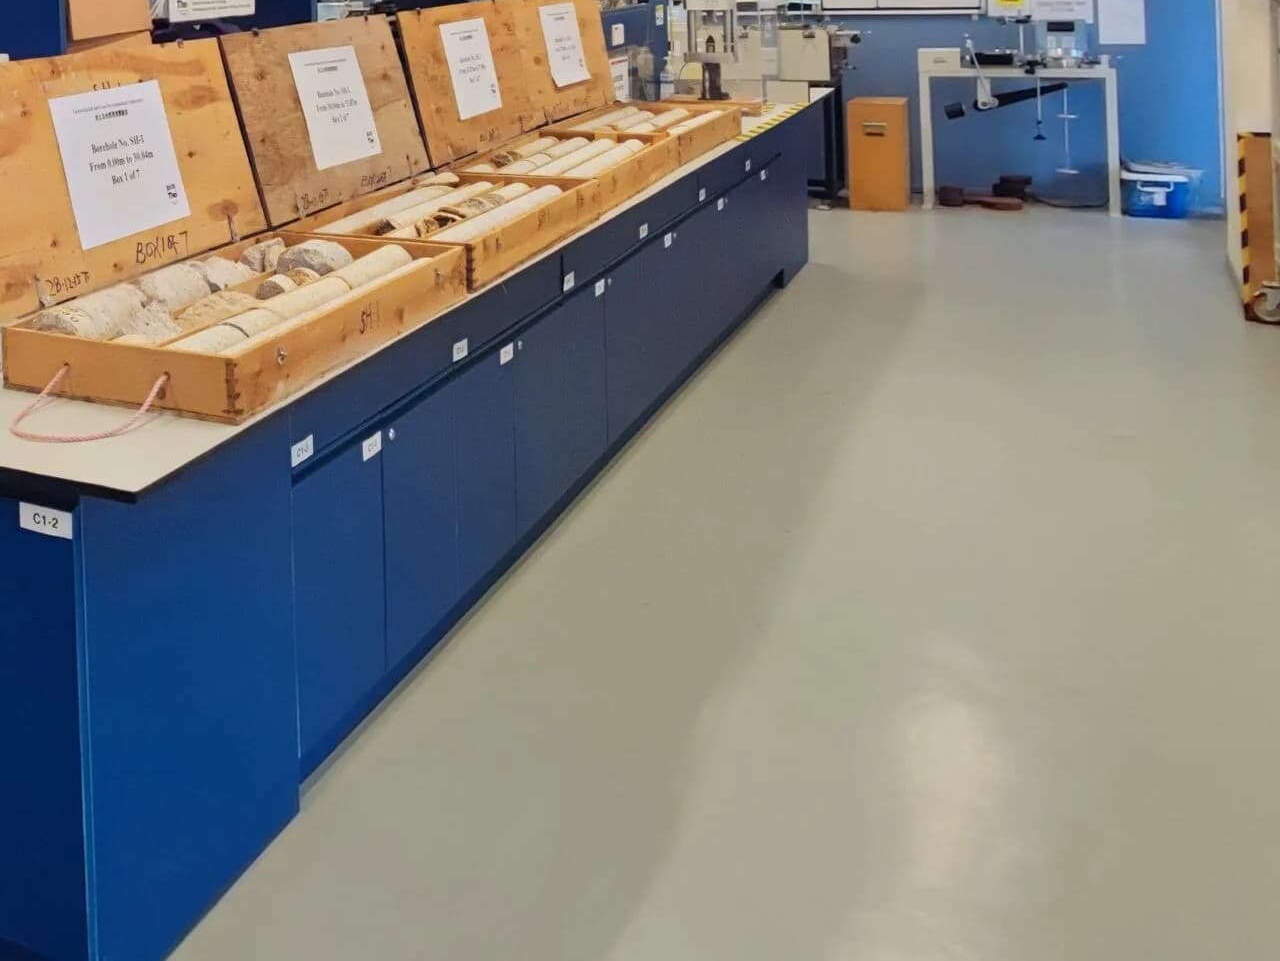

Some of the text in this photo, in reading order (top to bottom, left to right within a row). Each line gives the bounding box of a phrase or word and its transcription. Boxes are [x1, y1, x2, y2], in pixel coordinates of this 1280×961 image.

[91, 141, 118, 154] Borehole
[89, 162, 107, 173] From
[111, 174, 124, 185] Box
[32, 512, 59, 529] C1-2
